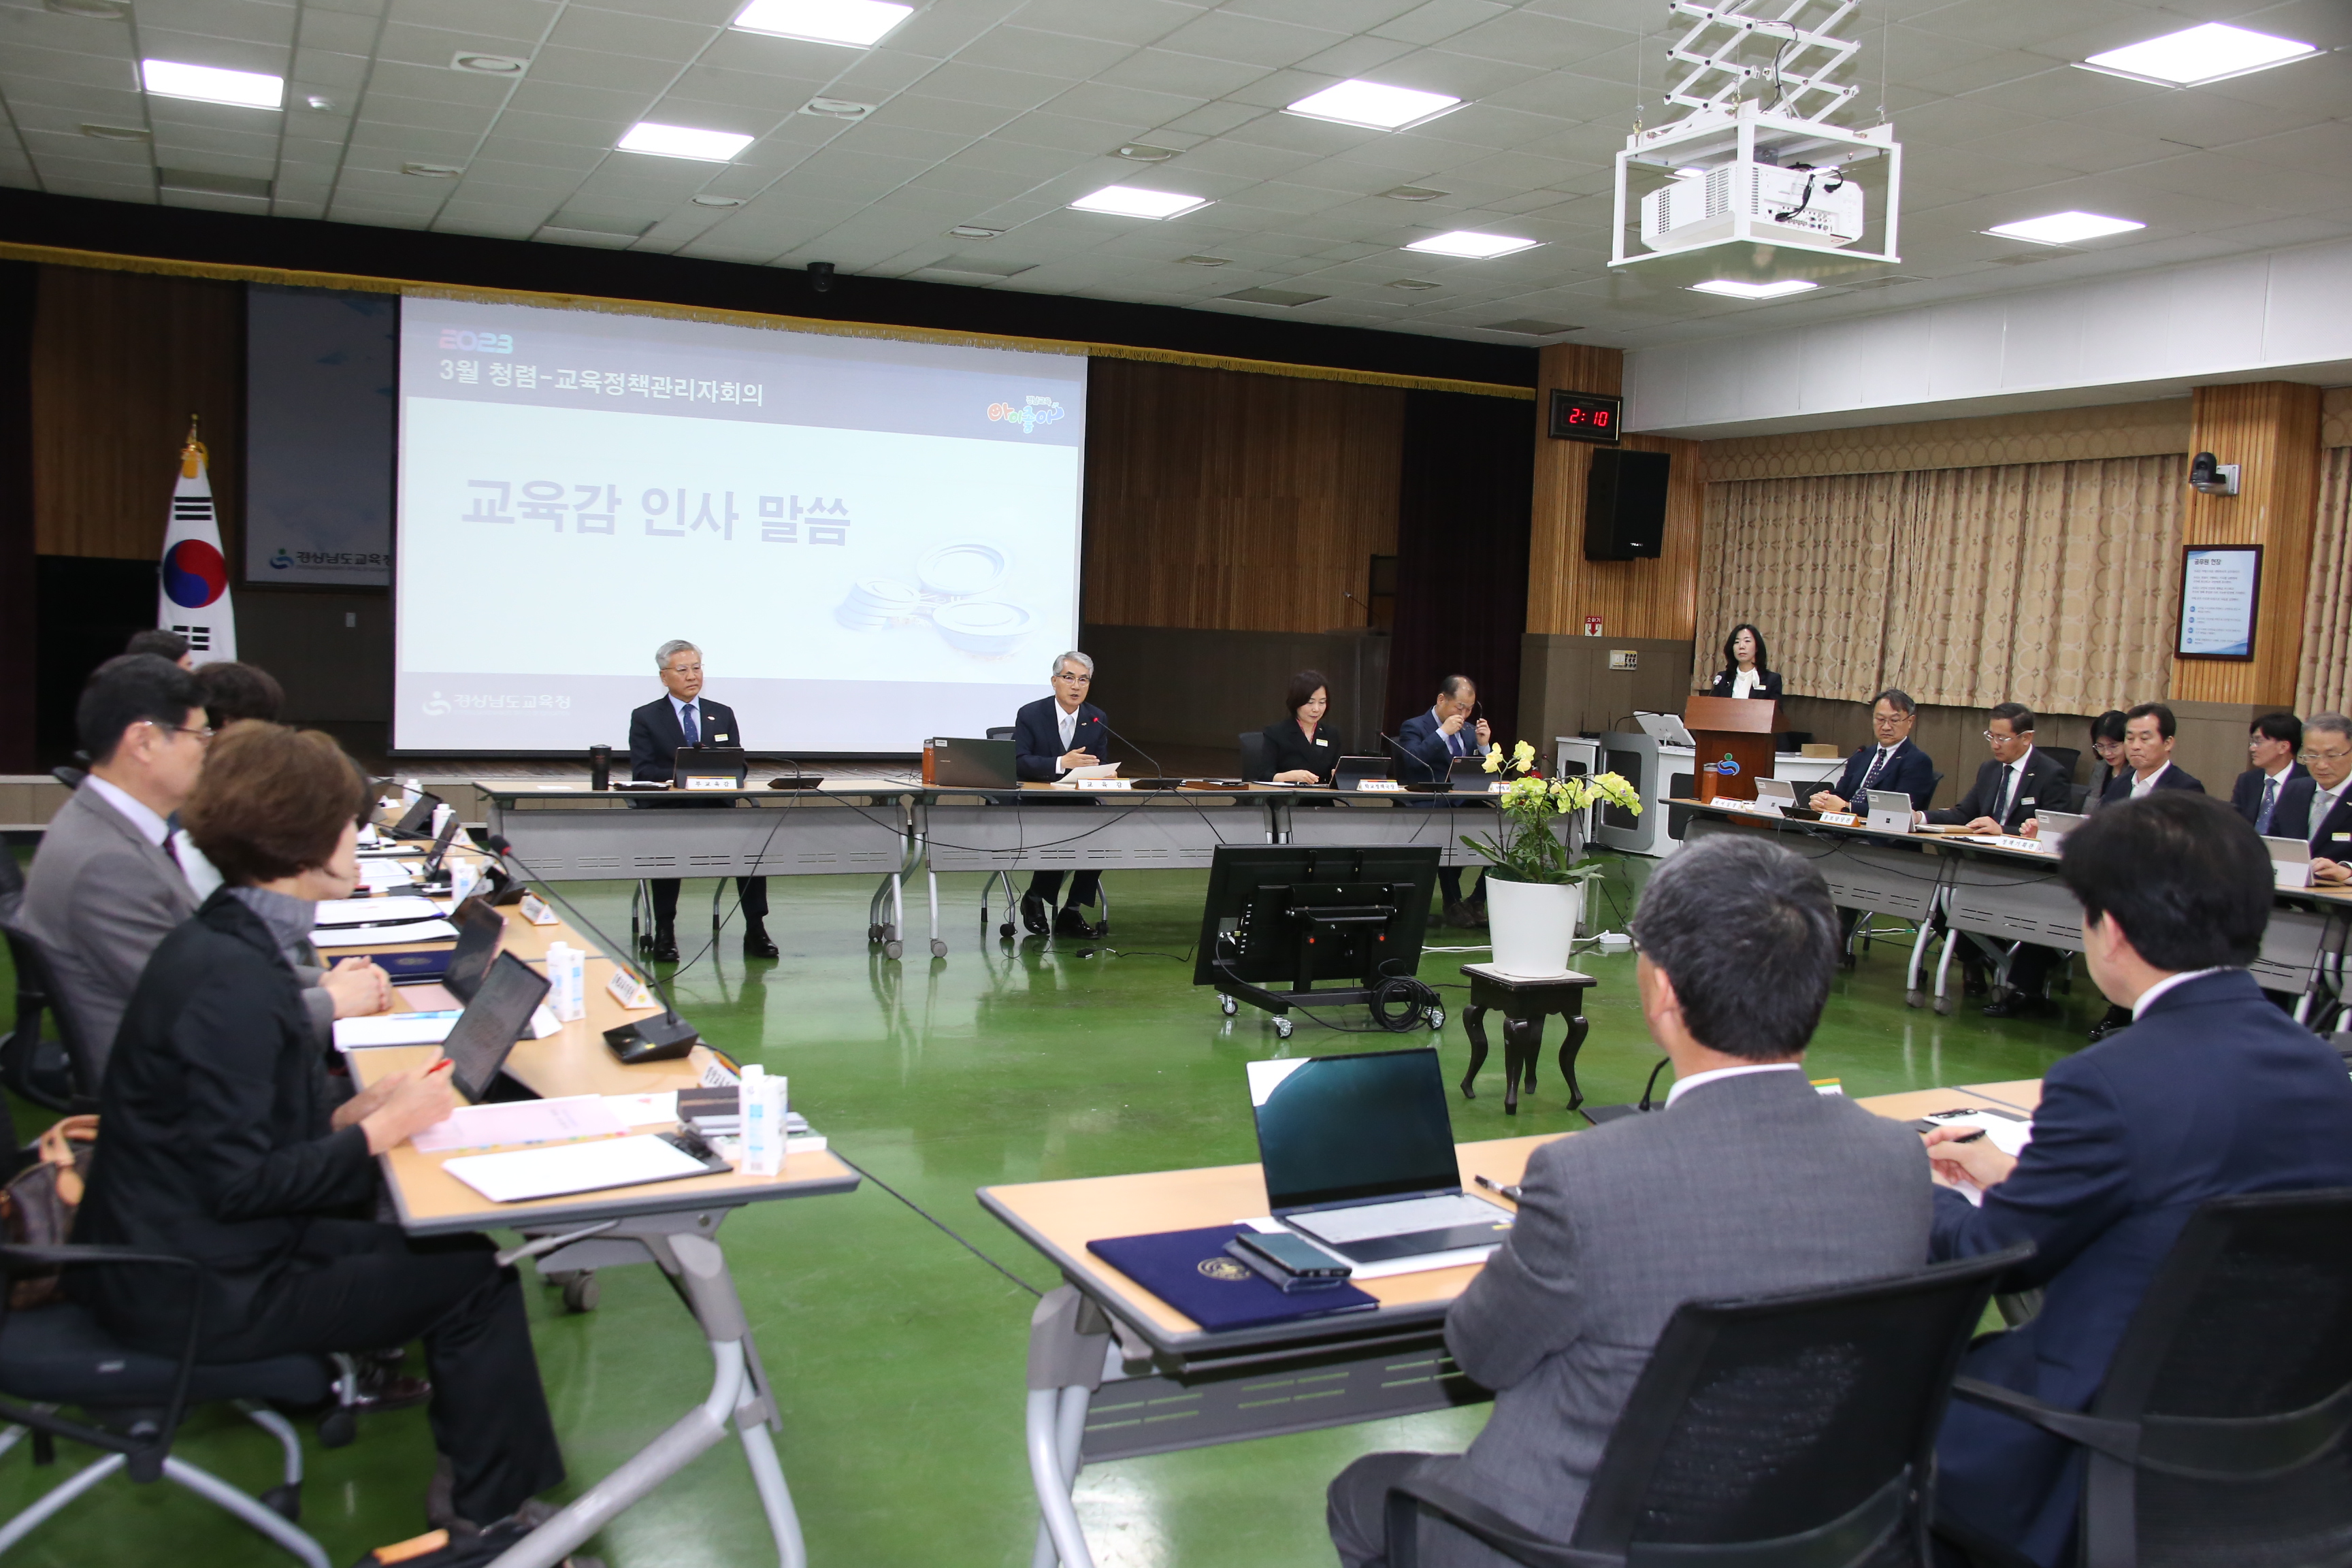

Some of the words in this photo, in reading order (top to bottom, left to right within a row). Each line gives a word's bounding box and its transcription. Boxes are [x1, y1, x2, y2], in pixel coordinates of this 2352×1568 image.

[439, 329, 513, 355] 2023
[440, 359, 479, 385] 3월
[489, 363, 763, 407] 청렴-교육정책관리자회의
[1026, 395, 1052, 406] 경남교육
[987, 402, 1065, 434] 아이좋아
[1569, 408, 1609, 427] 2:10
[461, 479, 622, 536] 교육감
[641, 487, 740, 541] 인사
[759, 495, 851, 546] 말씀
[453, 694, 571, 709] 경상남도교육청
